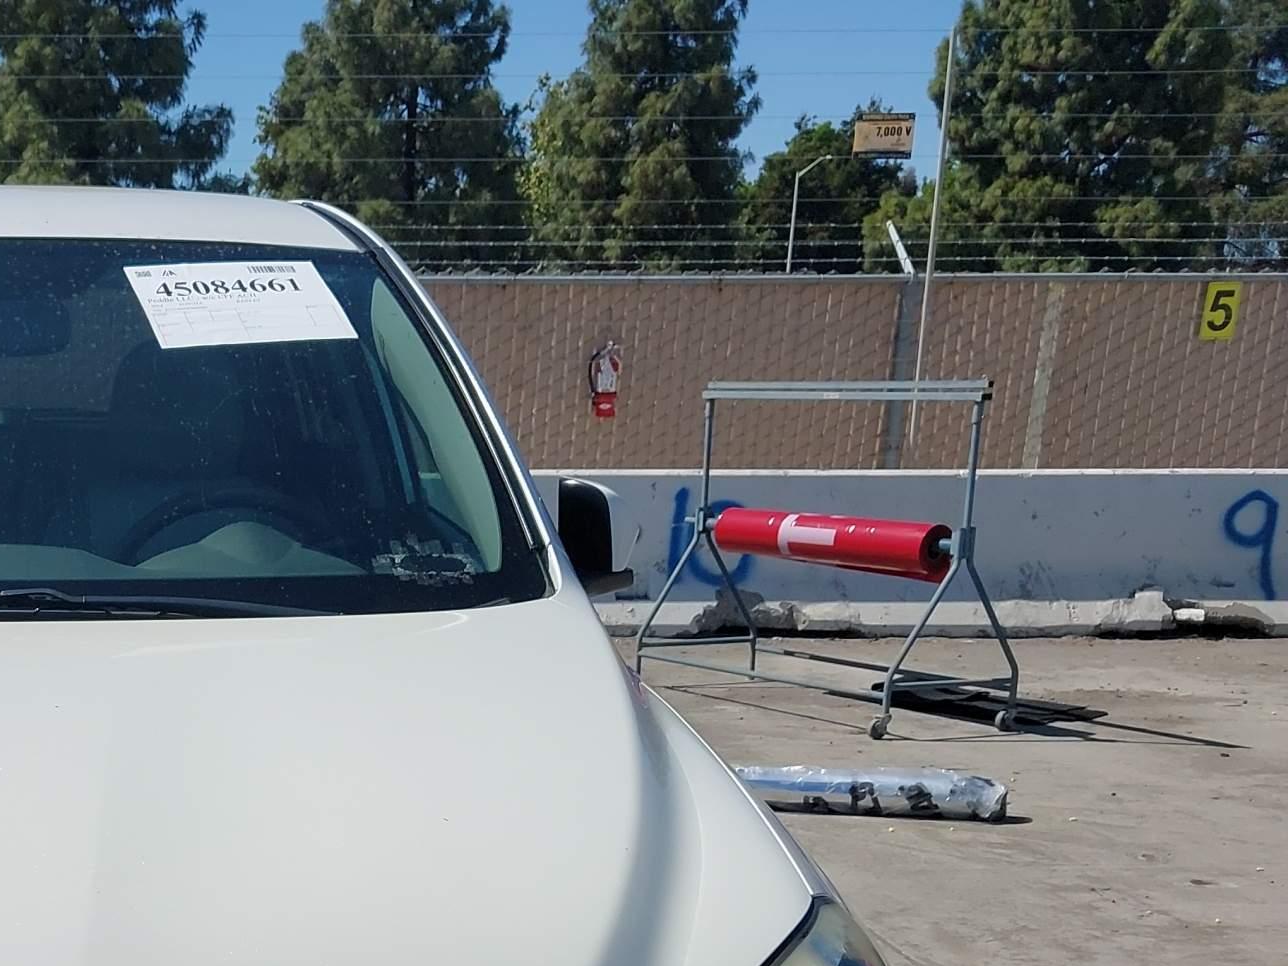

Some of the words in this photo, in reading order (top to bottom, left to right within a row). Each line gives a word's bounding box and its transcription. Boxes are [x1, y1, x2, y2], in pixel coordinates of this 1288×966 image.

[876, 126, 903, 137] 7,000
[905, 126, 912, 136] V
[156, 278, 302, 297] 45084661
[1207, 289, 1236, 332] 5
[1223, 489, 1279, 601] 9
